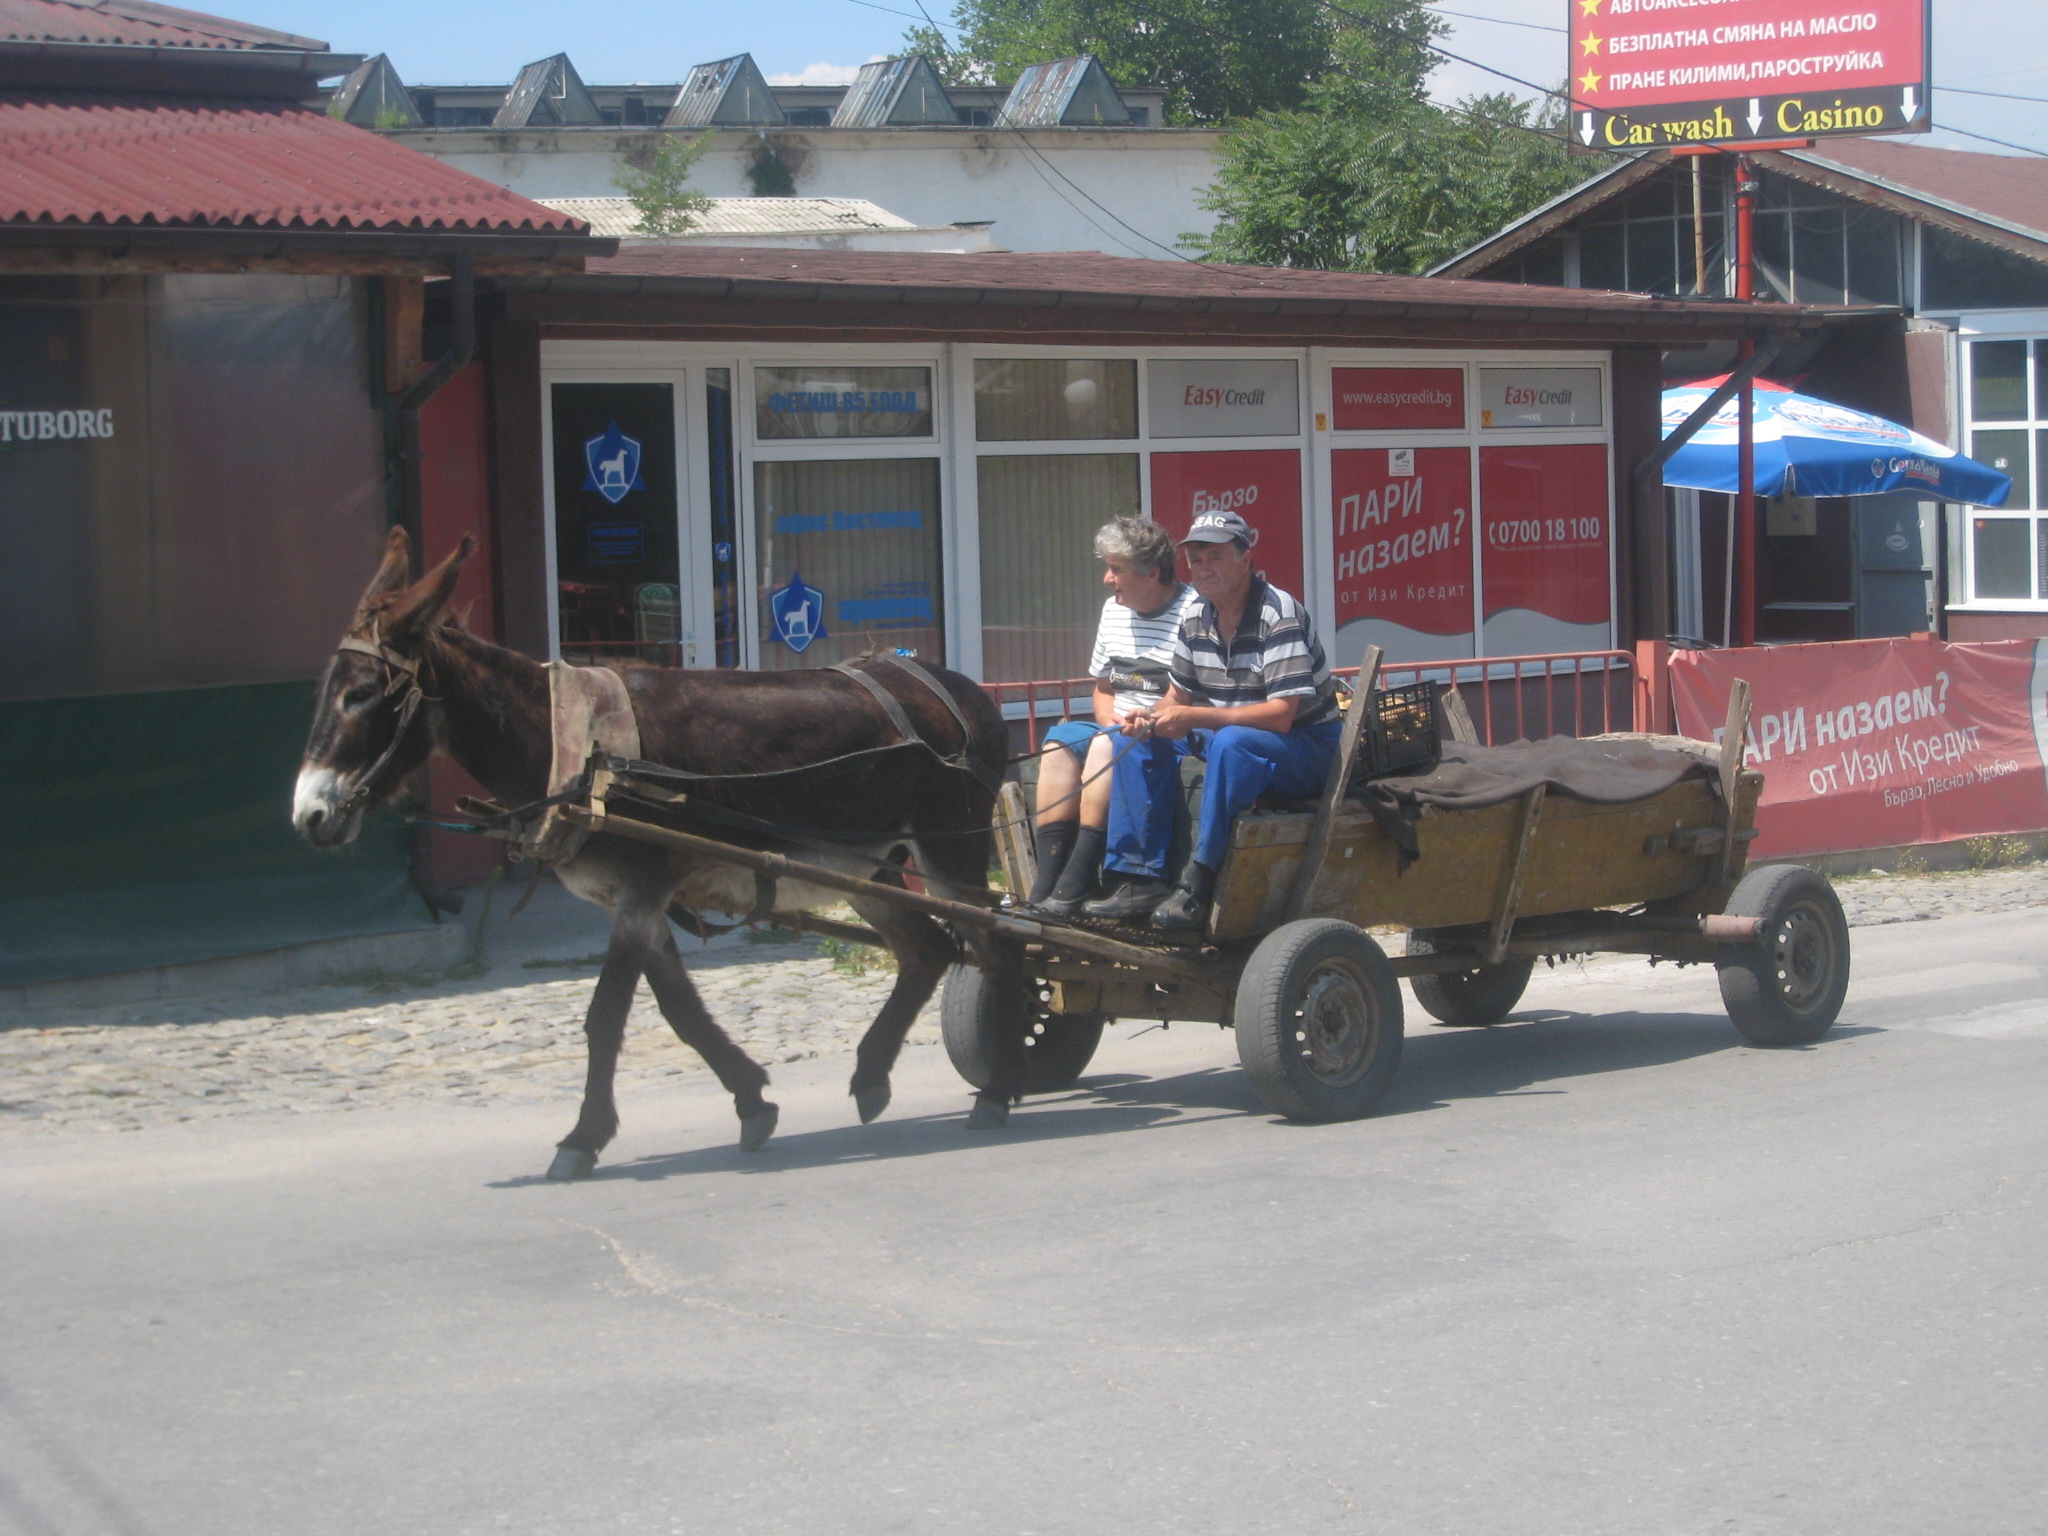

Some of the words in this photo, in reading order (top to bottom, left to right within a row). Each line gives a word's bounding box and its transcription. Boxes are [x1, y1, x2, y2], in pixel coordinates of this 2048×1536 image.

[1609, 30, 1709, 54] БЕЗПЛАТНА
[1712, 22, 1776, 45] СМЯНА
[1780, 20, 1805, 38] НА
[1809, 13, 1878, 36] МАСЛО
[1609, 71, 1666, 91] ПРАНЕ
[1604, 114, 1657, 146] Car
[1662, 105, 1734, 143] wash
[1777, 99, 1884, 133] Casino
[1343, 389, 1452, 407] www.easycredit.bg
[0, 408, 114, 441] TUBORG
[1339, 476, 1423, 536] ПАРИ
[1338, 508, 1466, 581] назаем?
[1499, 520, 1541, 544] 0700
[1545, 518, 1565, 541] 18
[1570, 517, 1600, 540] 100
[1341, 591, 1359, 604] от
[1368, 586, 1397, 602] Изи
[1407, 584, 1465, 602] Кредит
[1816, 671, 1950, 747] назаем?
[1809, 764, 1838, 795] от
[1841, 748, 1894, 786] Изи
[1895, 725, 1983, 775] Кредит
[1884, 784, 1926, 808] Бързо,
[1928, 774, 1965, 796] Лесно
[1966, 770, 1975, 784] и
[1974, 758, 2019, 784] Удобно
